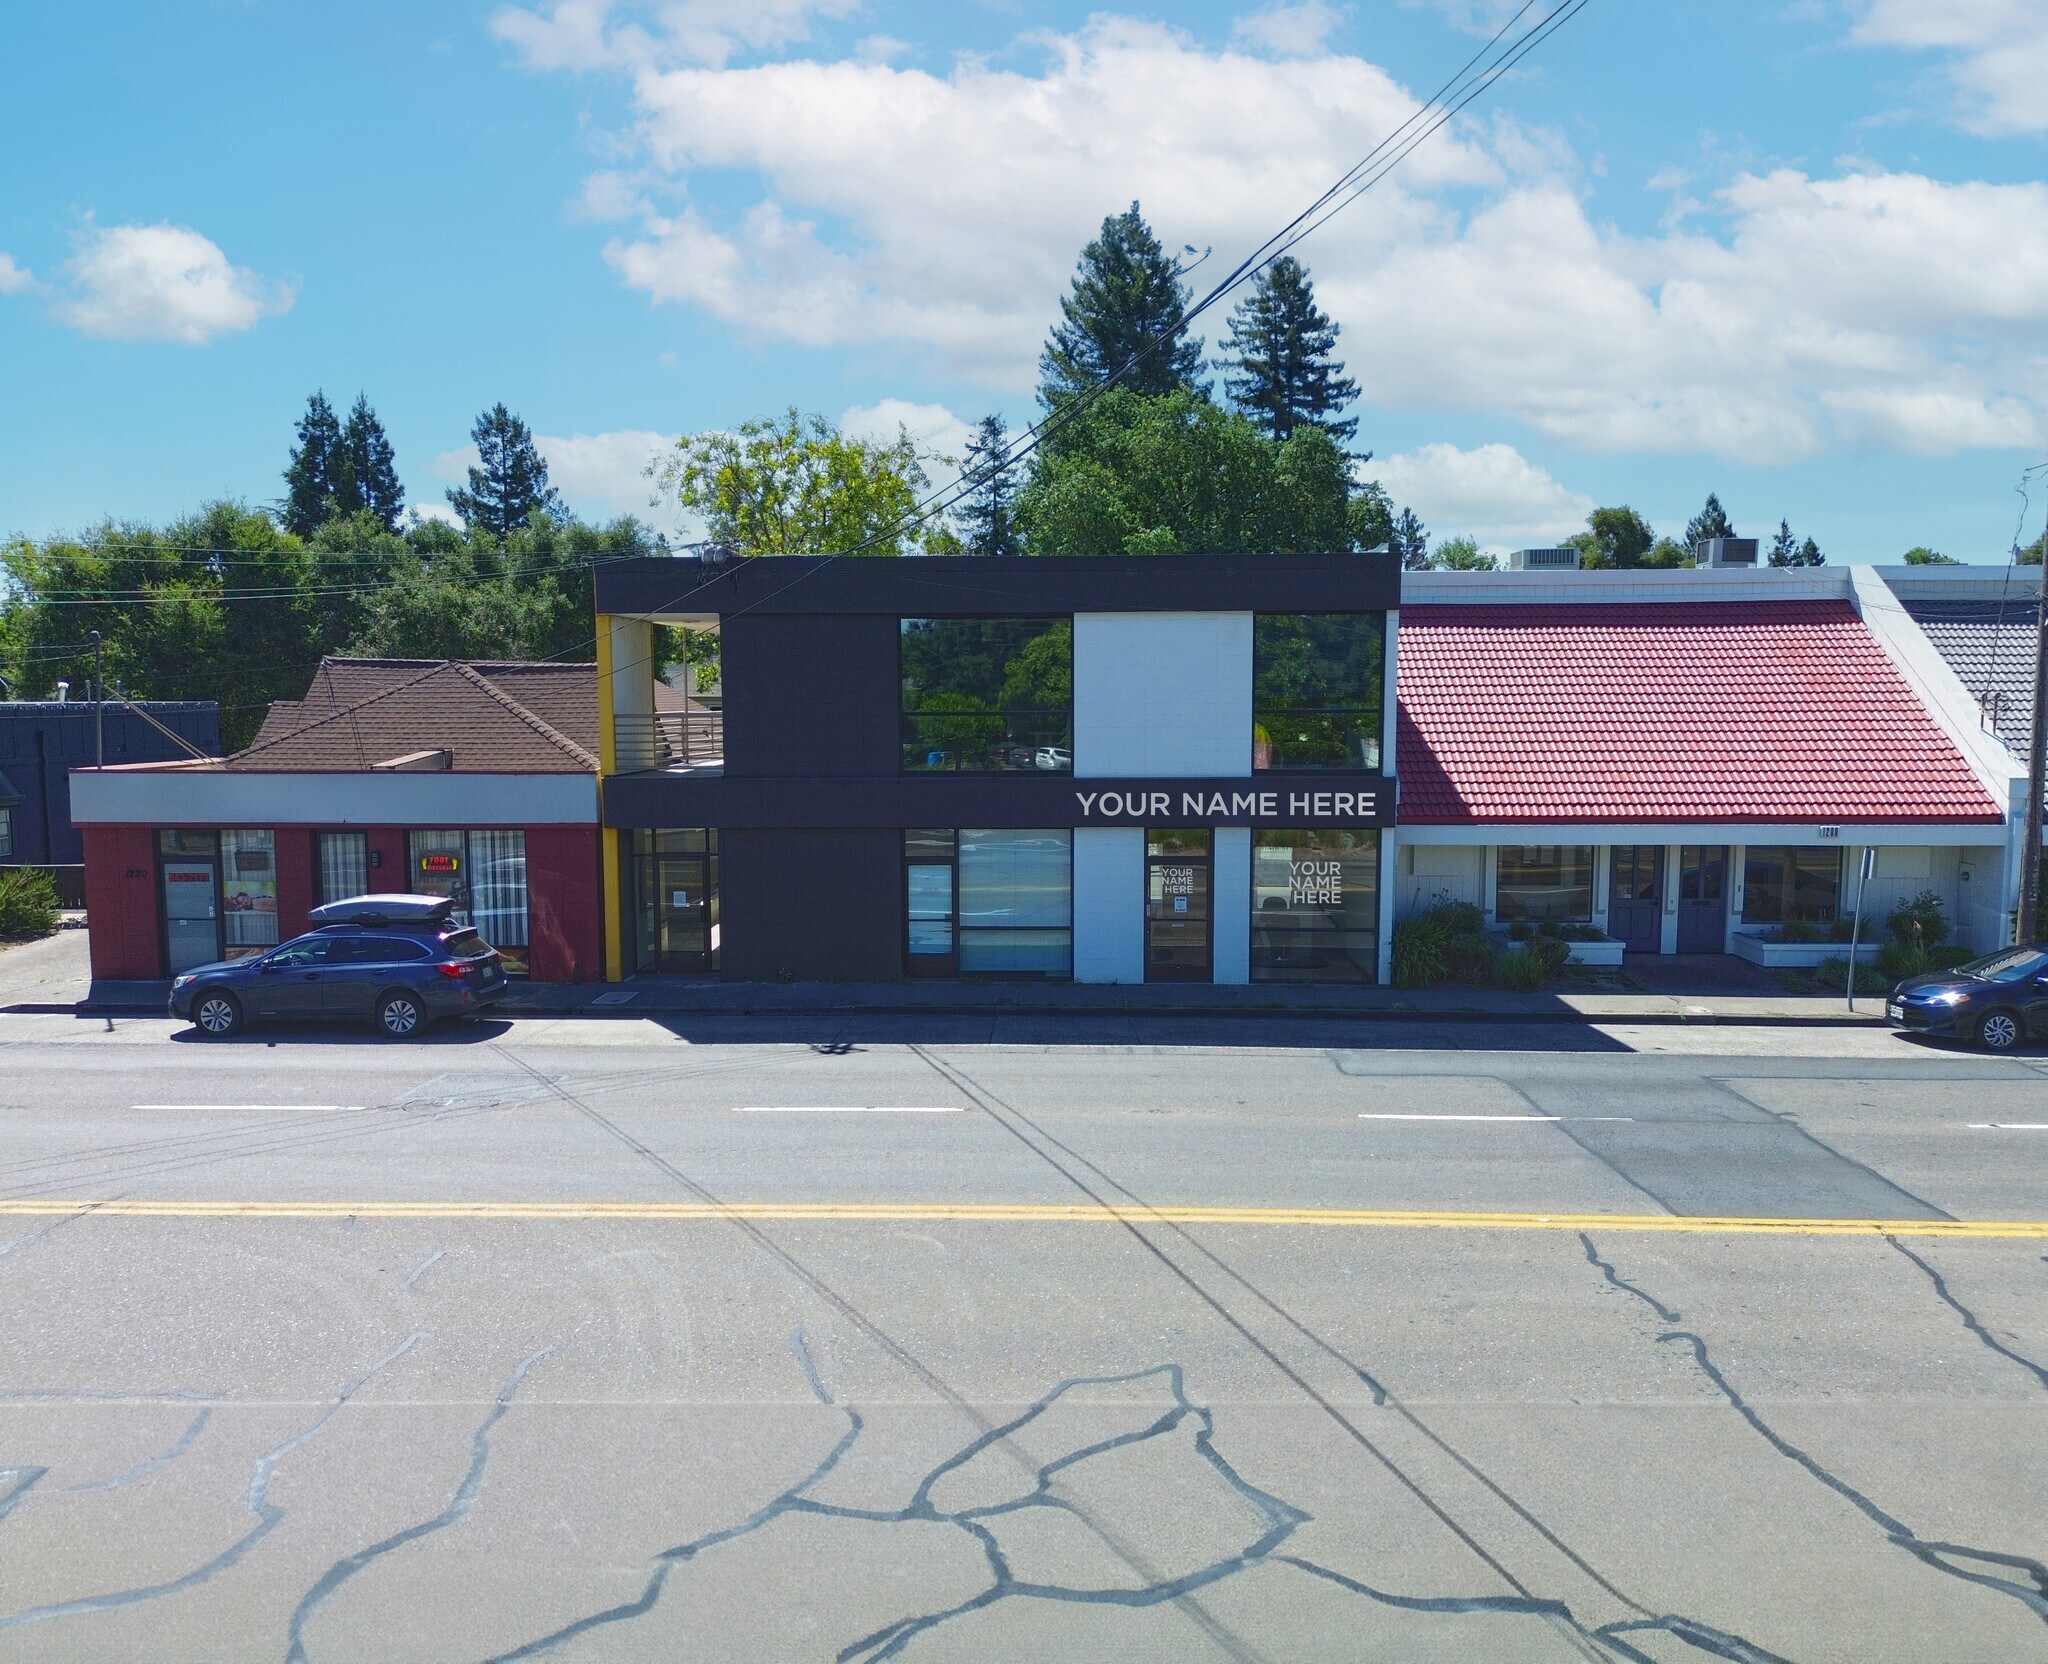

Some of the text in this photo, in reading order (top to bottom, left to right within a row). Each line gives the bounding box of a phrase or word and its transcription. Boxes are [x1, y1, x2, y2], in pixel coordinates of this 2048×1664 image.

[1075, 792, 1376, 816] YOUR NAME HERE
[1822, 827, 1839, 837] 1208
[430, 856, 449, 864] FOOT
[1162, 868, 1193, 877] YOUR
[1288, 861, 1341, 875] YOUR
[1162, 877, 1194, 885] NAME
[1288, 876, 1342, 889] NAME
[1164, 885, 1194, 894] HERE
[1293, 890, 1342, 904] HERE
